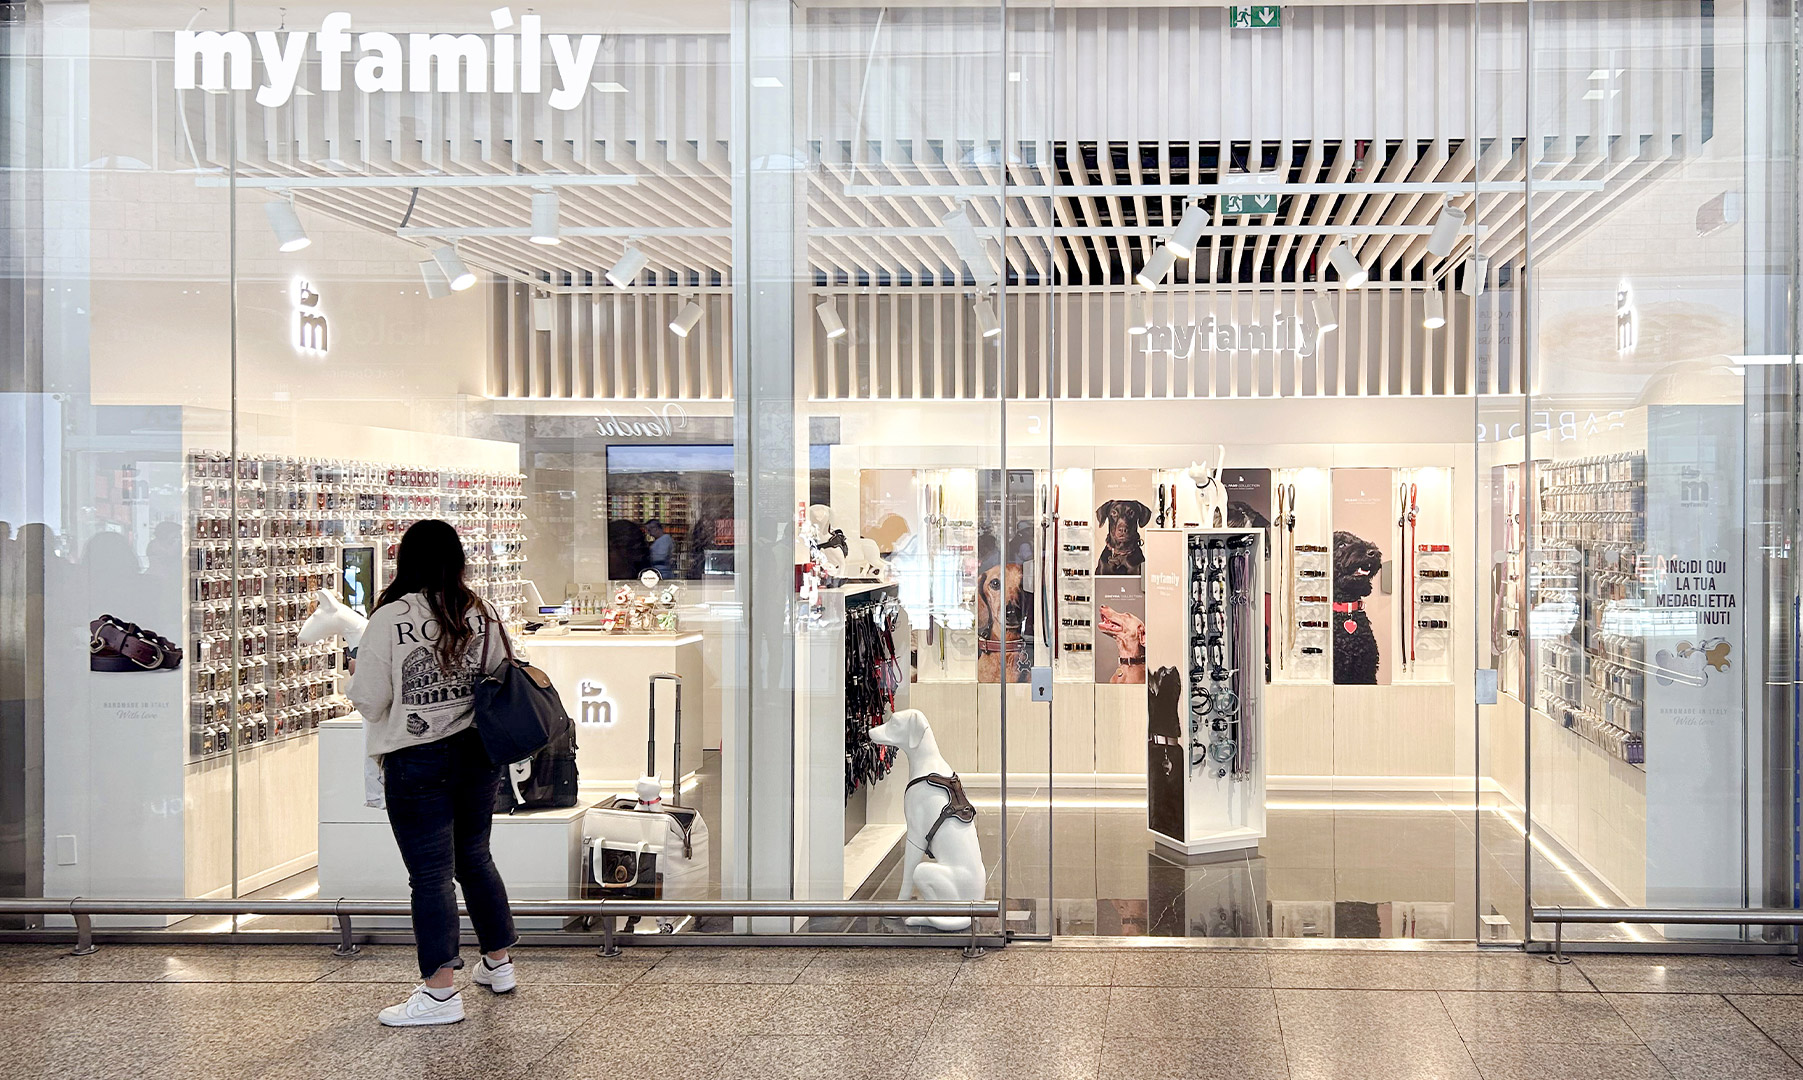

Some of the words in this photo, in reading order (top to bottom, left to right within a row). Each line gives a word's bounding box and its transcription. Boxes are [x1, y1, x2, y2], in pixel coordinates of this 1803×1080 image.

[173, 7, 602, 111] myfamily
[1140, 312, 1319, 359] myfamily
[1666, 560, 1702, 573] INCIDI
[1706, 560, 1726, 574] QUI
[1151, 572, 1180, 587] myfamily
[1676, 577, 1690, 590] LA
[1693, 577, 1716, 590] TUA
[1656, 594, 1736, 608] MEDAGLIETTA
[394, 614, 486, 647] ROE
[582, 700, 611, 722] m
